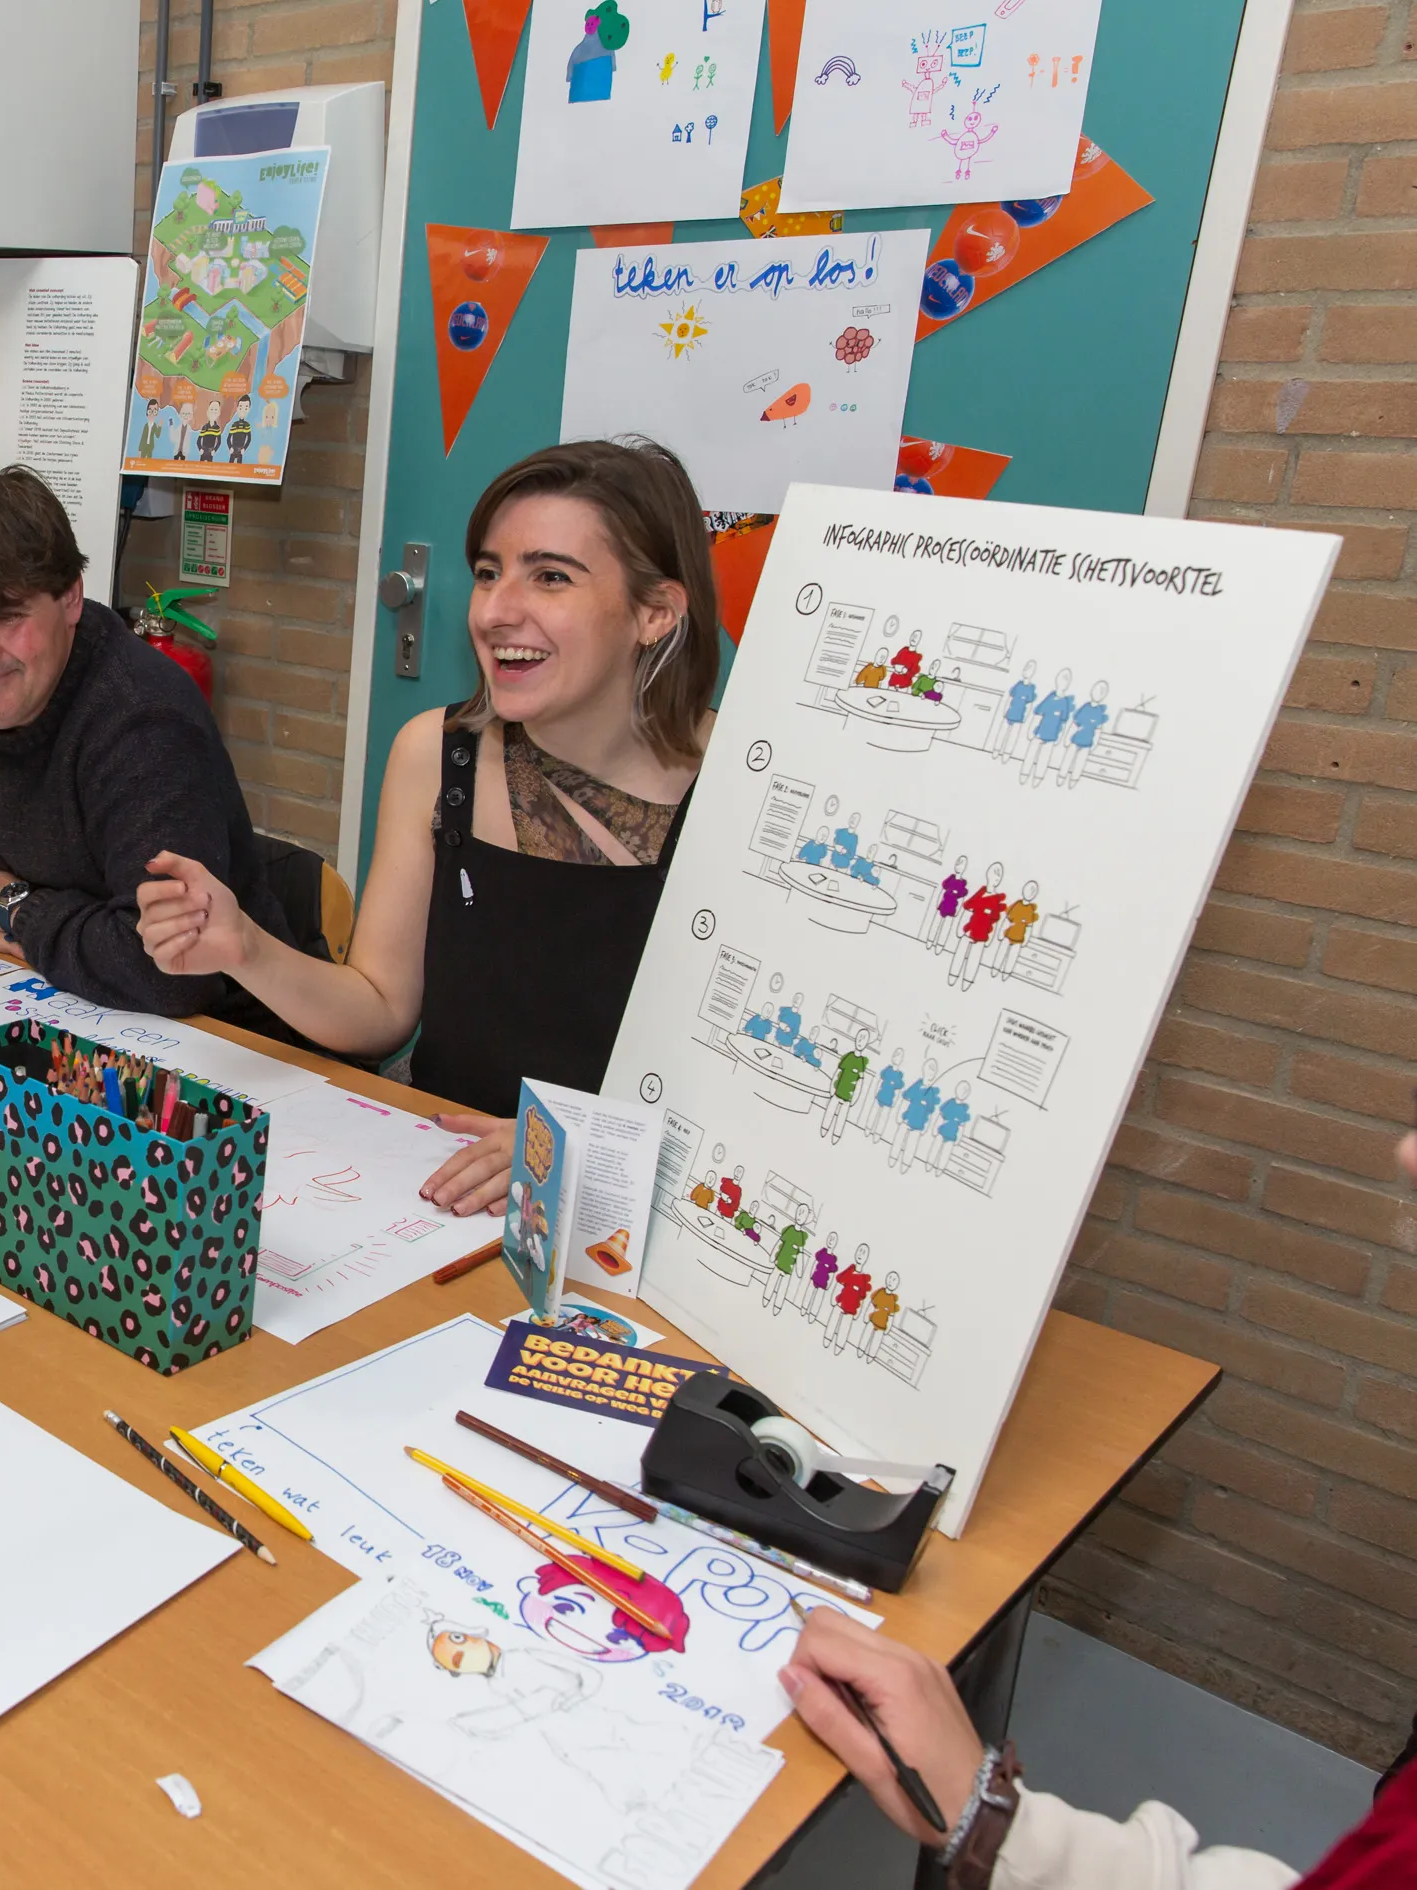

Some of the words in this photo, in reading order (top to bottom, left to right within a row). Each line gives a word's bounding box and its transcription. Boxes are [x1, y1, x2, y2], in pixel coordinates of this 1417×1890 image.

[613, 255, 695, 295] teken
[714, 262, 738, 291] er
[749, 262, 794, 298] op
[823, 523, 914, 560] INFOGRAPHIC
[1068, 552, 1224, 597] SCHETSVOORSTEL
[120, 1026, 181, 1050] een
[519, 1348, 620, 1386] VOOR
[623, 1374, 680, 1400] HE
[282, 1486, 321, 1514] wat
[340, 1523, 393, 1564] leuk
[421, 1543, 463, 1569] 18
